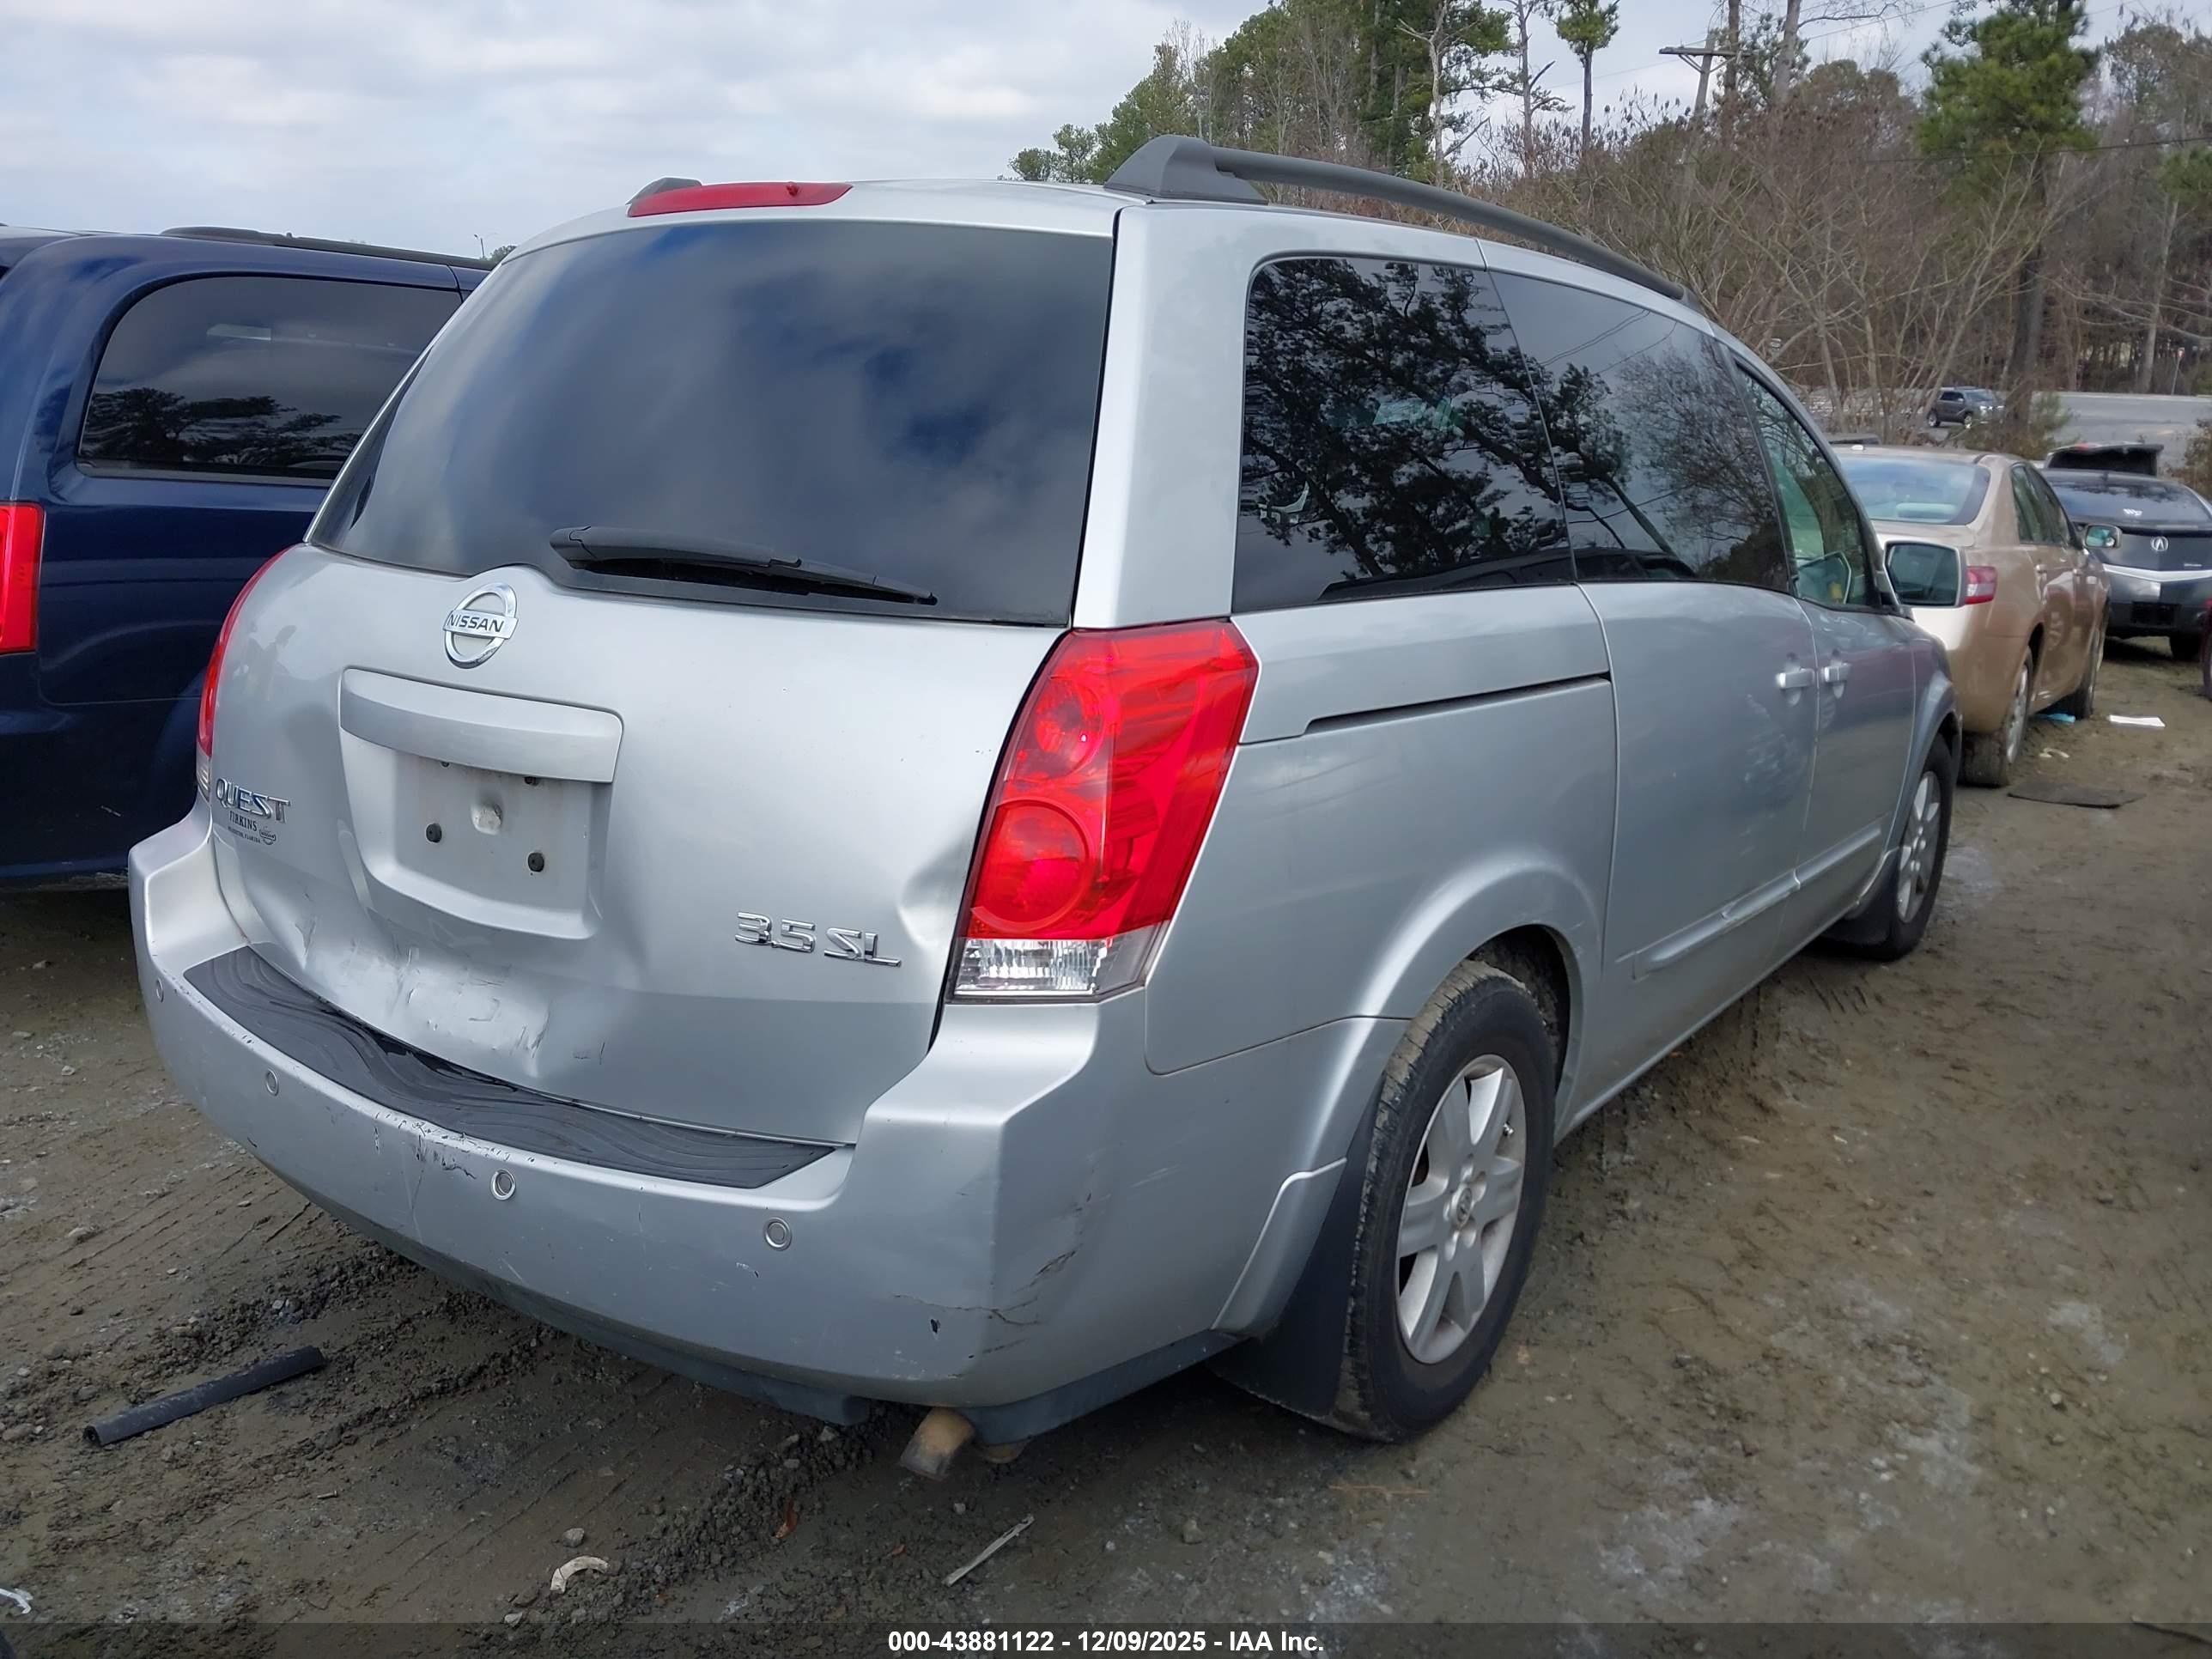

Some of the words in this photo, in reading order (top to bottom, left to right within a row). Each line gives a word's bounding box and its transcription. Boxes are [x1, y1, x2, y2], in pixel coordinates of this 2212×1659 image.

[447, 614, 505, 633] NISSAN
[216, 777, 291, 823] QUEST
[823, 927, 902, 967] SL
